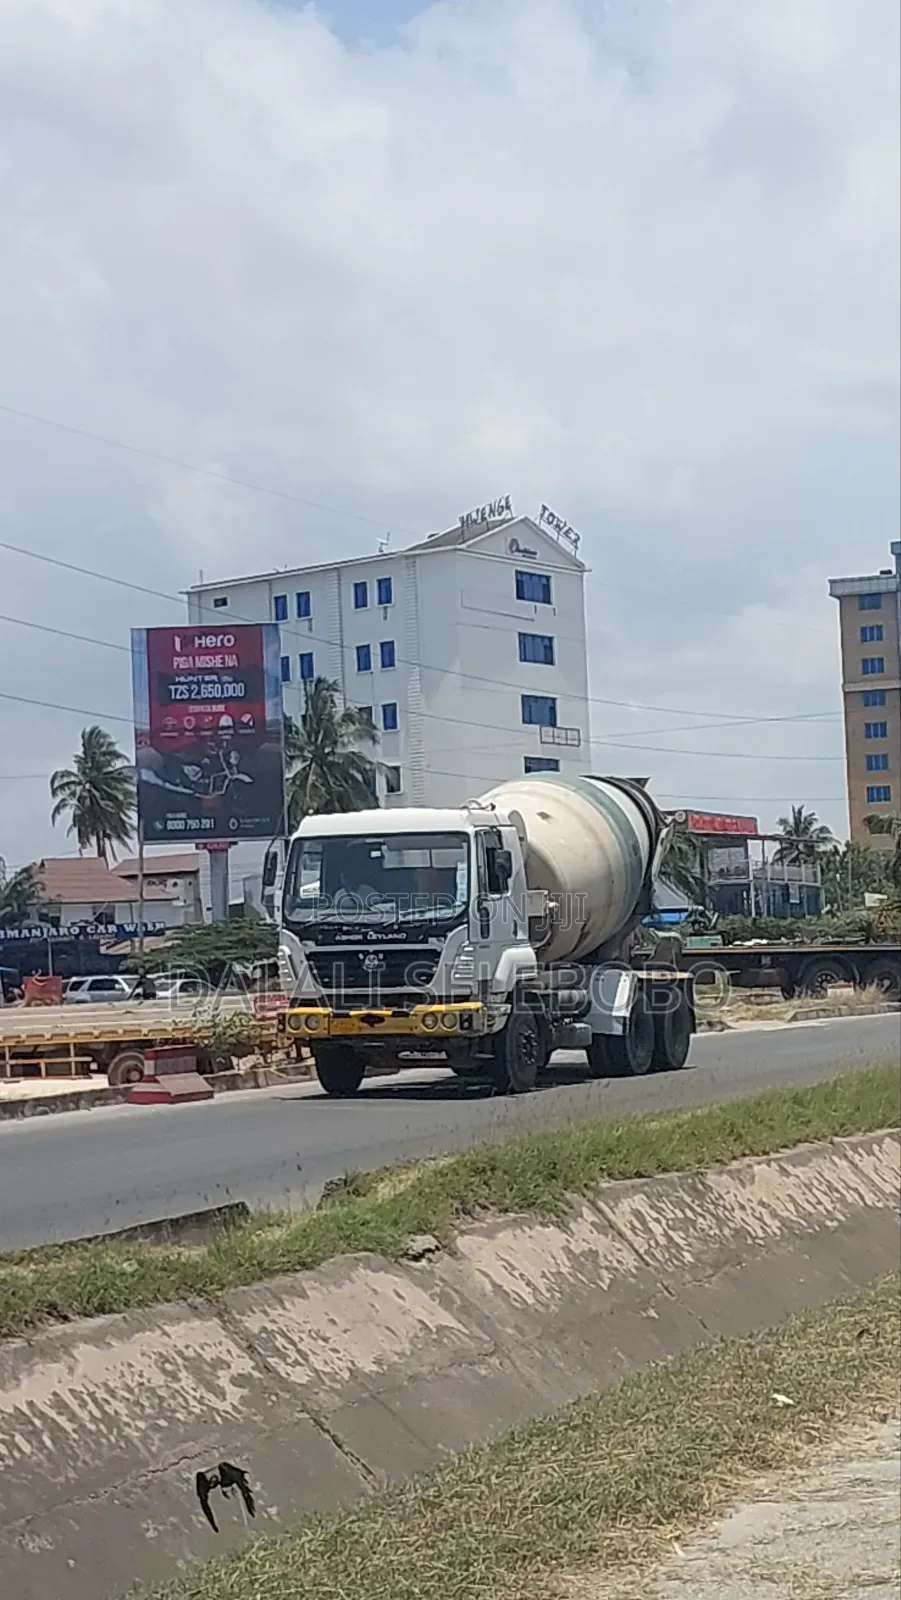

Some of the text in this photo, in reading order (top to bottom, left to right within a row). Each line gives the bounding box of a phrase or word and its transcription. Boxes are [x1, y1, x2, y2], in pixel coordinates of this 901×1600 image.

[541, 503, 581, 549] TOWER
[168, 682, 245, 699] TZS 2,650,000
[86, 923, 118, 934] CAR
